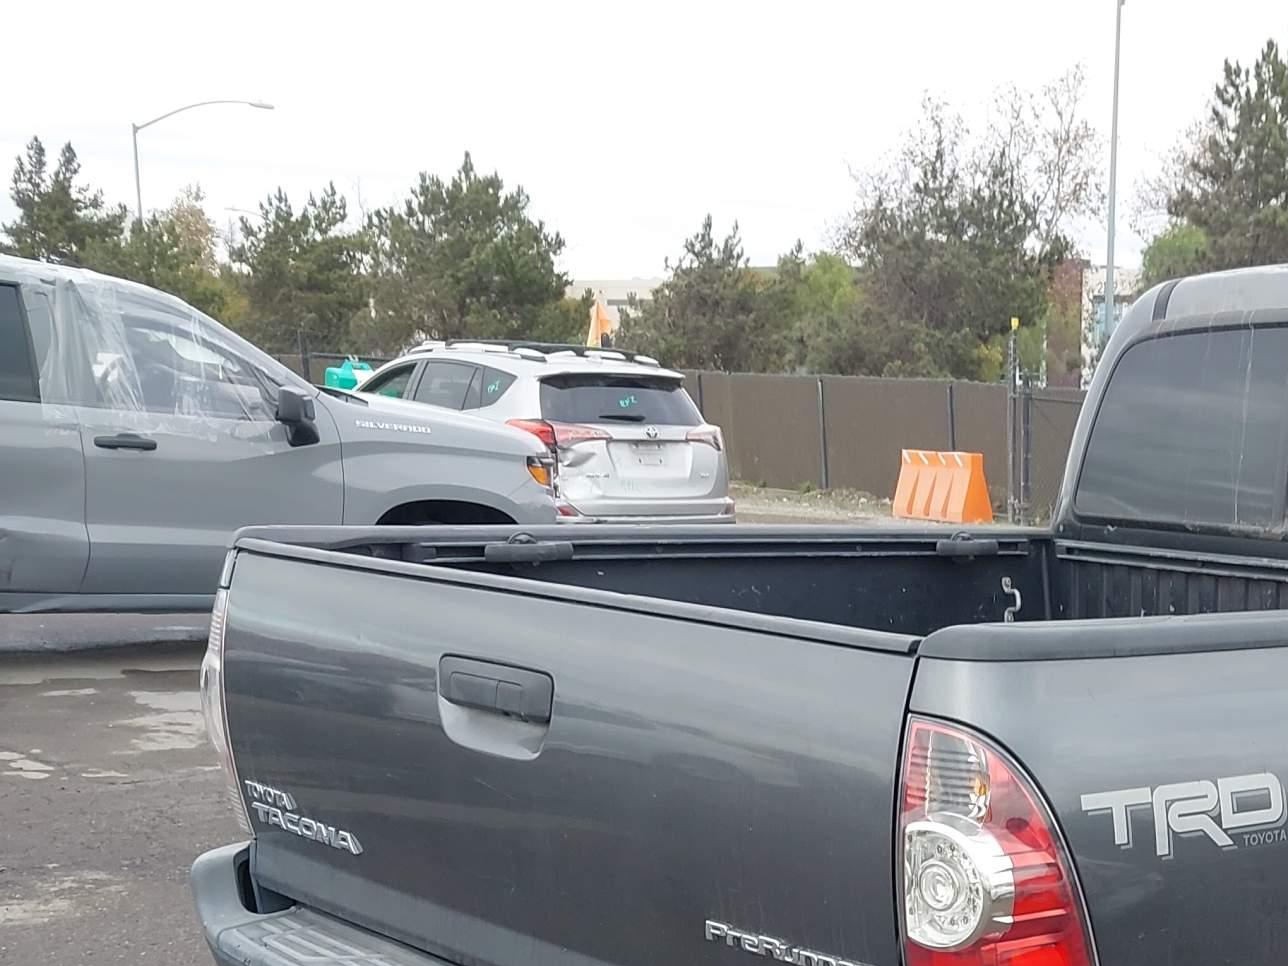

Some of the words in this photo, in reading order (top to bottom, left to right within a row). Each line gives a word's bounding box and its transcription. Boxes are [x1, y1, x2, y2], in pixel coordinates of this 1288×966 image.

[245, 780, 297, 810] TOYOTA
[1080, 772, 1287, 860] TRD
[252, 801, 363, 855] TACOMA
[1243, 829, 1287, 847] TOYOTA
